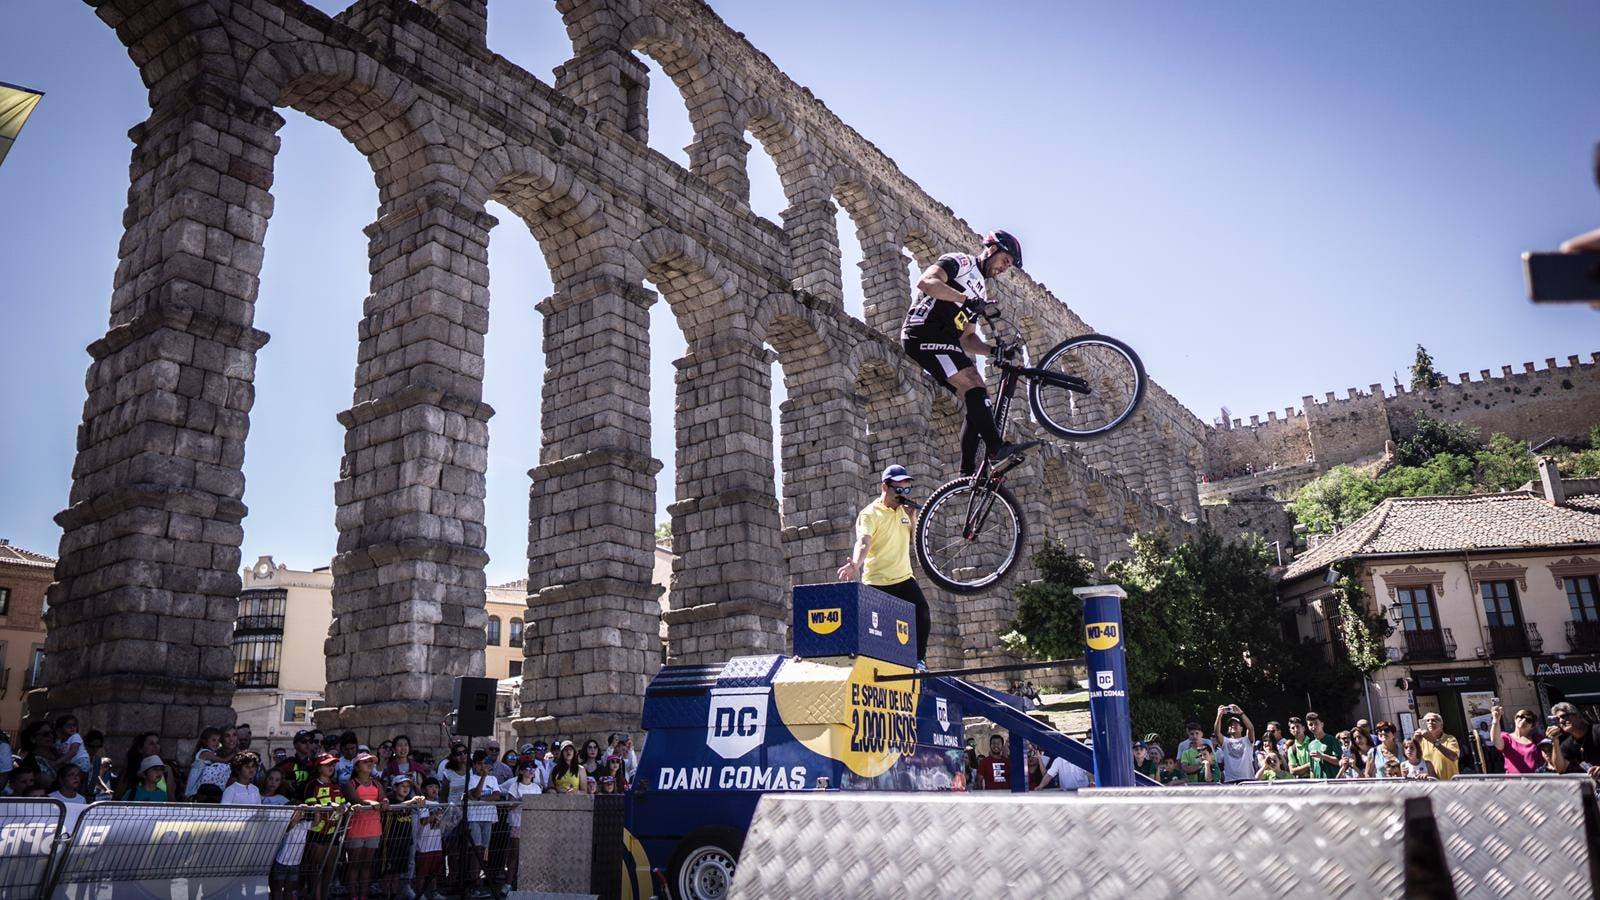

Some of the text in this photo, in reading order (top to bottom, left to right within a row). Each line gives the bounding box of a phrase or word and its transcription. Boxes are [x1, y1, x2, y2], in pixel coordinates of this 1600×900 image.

[862, 685, 887, 709] SPRAY
[889, 689, 898, 711] DE
[900, 692, 913, 713] LOS
[714, 706, 758, 737] DC
[851, 708, 917, 757] 2.000 USOS
[658, 766, 807, 790] DANI COMAS
